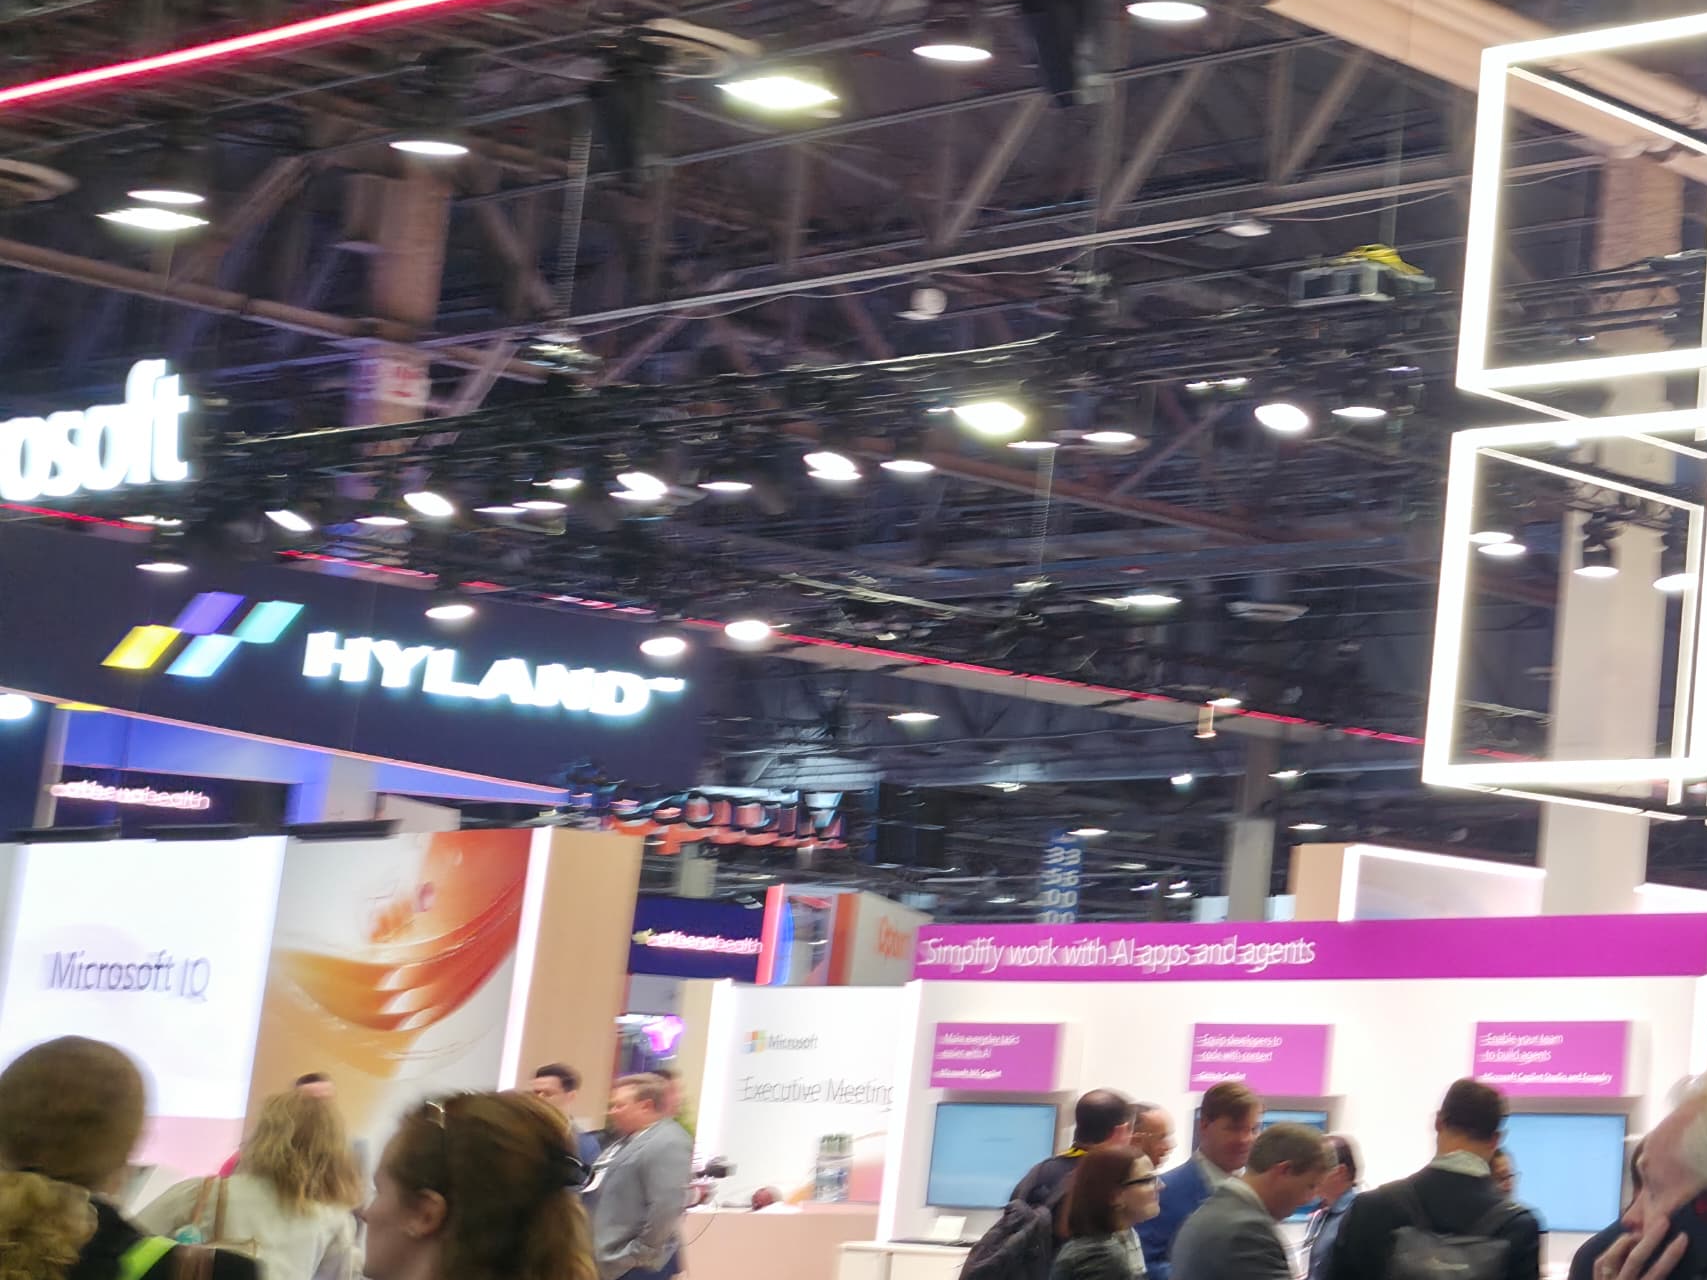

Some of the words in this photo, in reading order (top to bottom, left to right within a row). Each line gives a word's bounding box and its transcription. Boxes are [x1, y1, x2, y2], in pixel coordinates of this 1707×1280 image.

[302, 631, 655, 717] HYLAND
[46, 950, 175, 991] Microsoft
[919, 935, 1004, 974] Simplify
[1008, 937, 1058, 965] work
[1062, 936, 1107, 966] with
[1137, 945, 1190, 974] apps
[1192, 935, 1238, 966] and
[1239, 938, 1316, 974] agents
[737, 1075, 822, 1103] Executive
